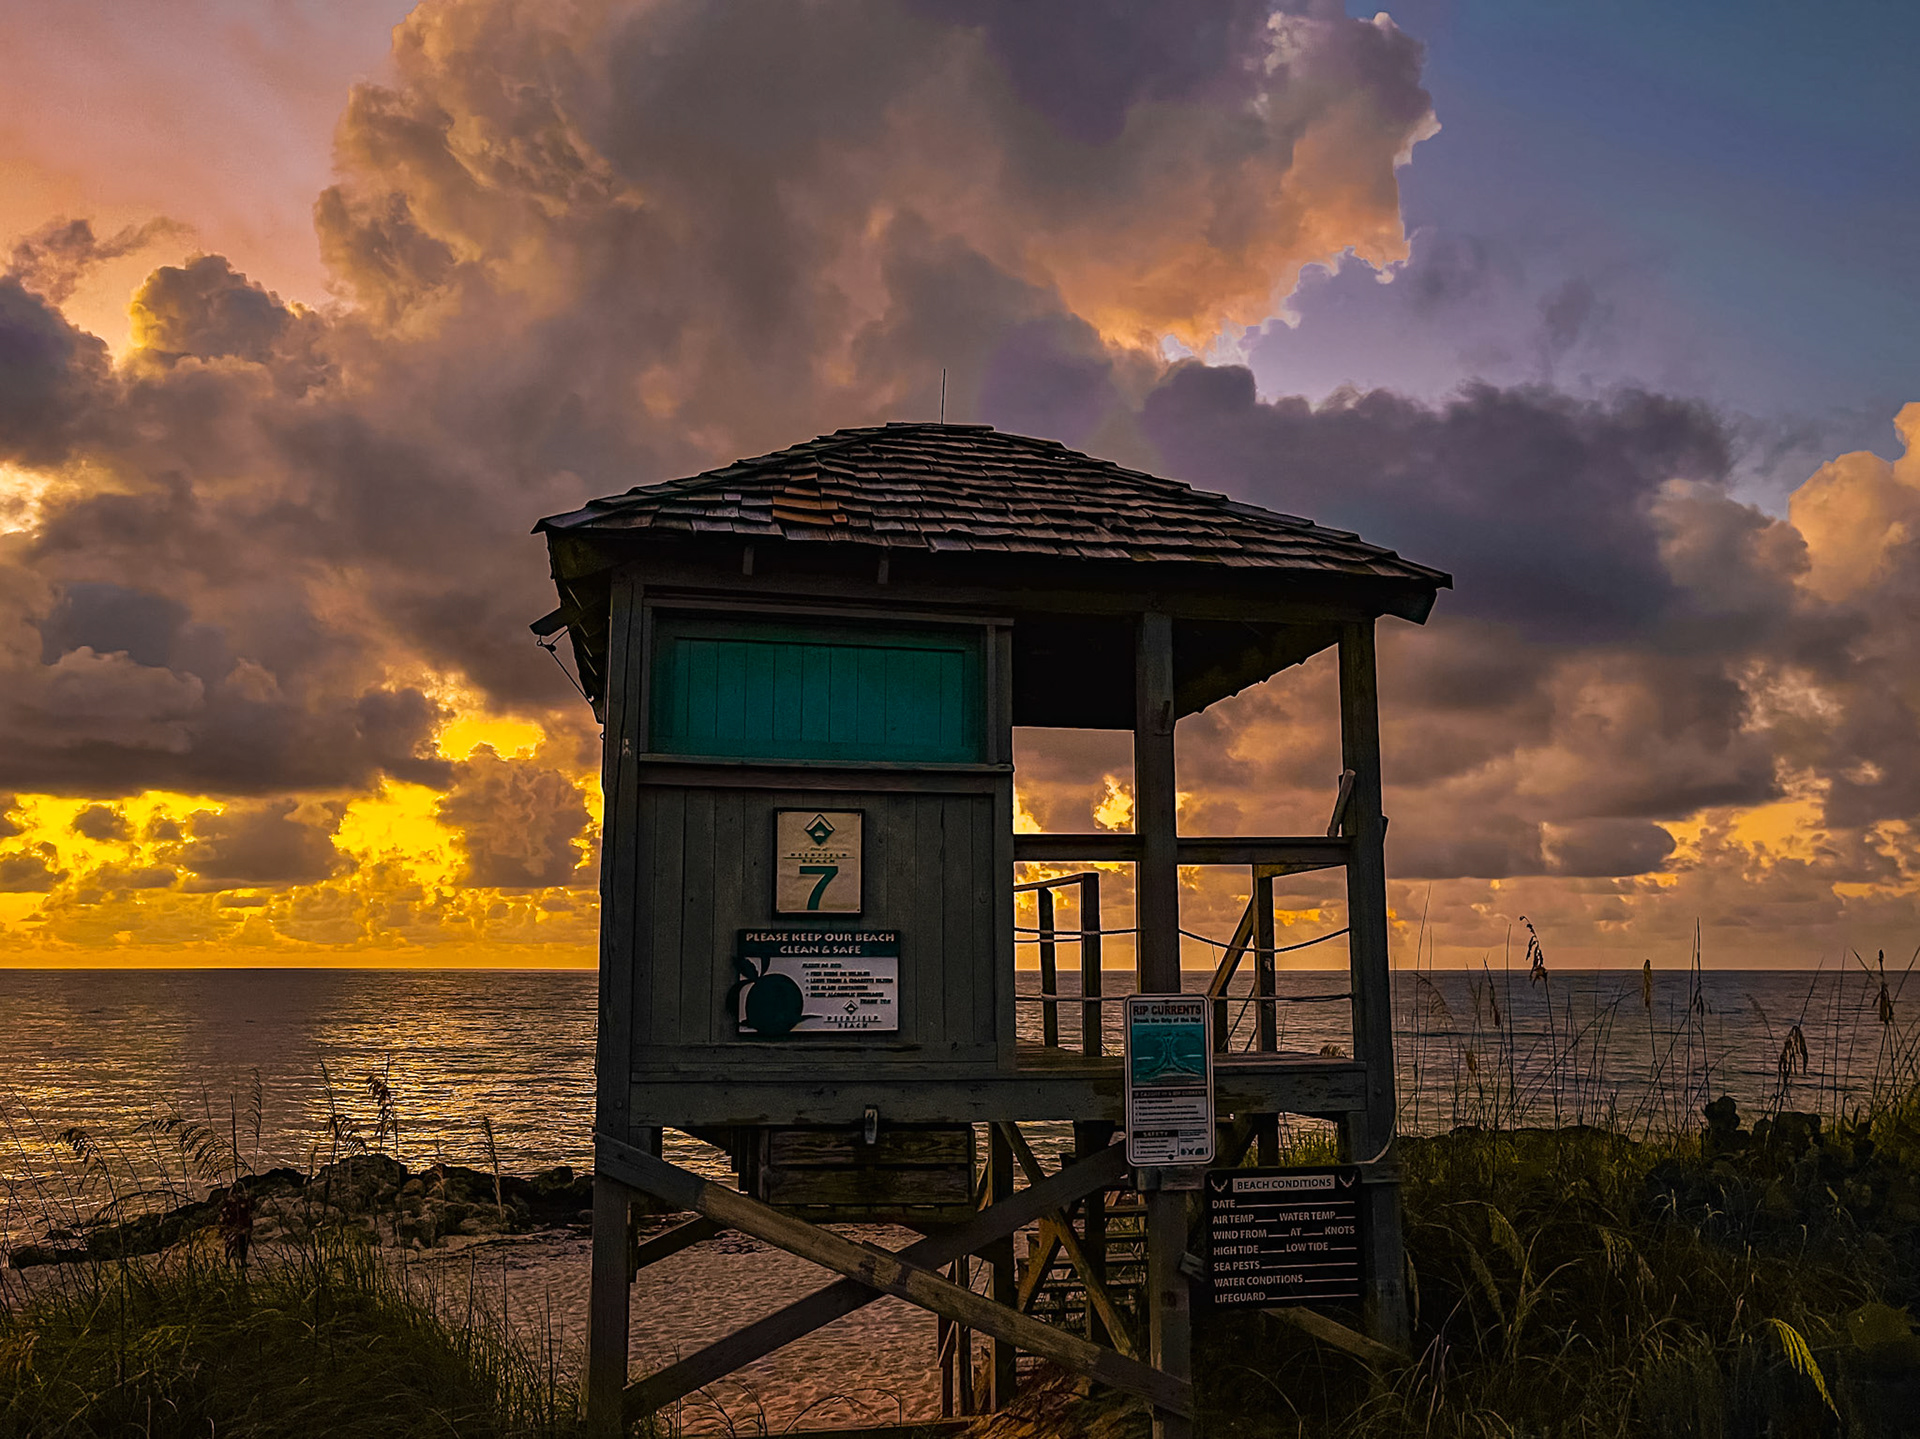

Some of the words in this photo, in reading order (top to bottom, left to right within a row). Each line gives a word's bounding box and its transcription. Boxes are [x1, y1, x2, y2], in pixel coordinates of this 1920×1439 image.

[799, 866, 839, 910] 7
[746, 933, 788, 942] PLEASE
[792, 933, 822, 941] KEEP
[824, 933, 852, 941] OUR
[855, 933, 895, 942] BEACH
[780, 945, 819, 954] CLEAN
[821, 946, 830, 954] &
[833, 946, 862, 954] SAFE
[1133, 1005, 1149, 1016] RIP
[1151, 1005, 1202, 1015] CURRENTS
[1237, 1179, 1270, 1190] BEACH
[1272, 1178, 1332, 1188] CONDITIONS
[1212, 1199, 1236, 1209] DATE
[1212, 1215, 1228, 1225] AIR
[1229, 1214, 1254, 1224] TEMP
[1279, 1212, 1310, 1222] WATER
[1311, 1211, 1336, 1220] TEMP
[1213, 1230, 1239, 1240] WIND
[1240, 1229, 1267, 1239] FROM
[1290, 1228, 1302, 1237] AT
[1324, 1226, 1355, 1235] KNOTS
[1213, 1246, 1237, 1256] HIGH
[1238, 1245, 1259, 1254] TIDE
[1286, 1243, 1307, 1253] LOW
[1308, 1242, 1329, 1251] TIDE
[1213, 1262, 1231, 1272] SEA
[1233, 1260, 1260, 1270] PESTS
[1214, 1277, 1245, 1288] WATER
[1246, 1274, 1303, 1286] CONDITIONS
[1214, 1292, 1266, 1303] LIFEGUARD
